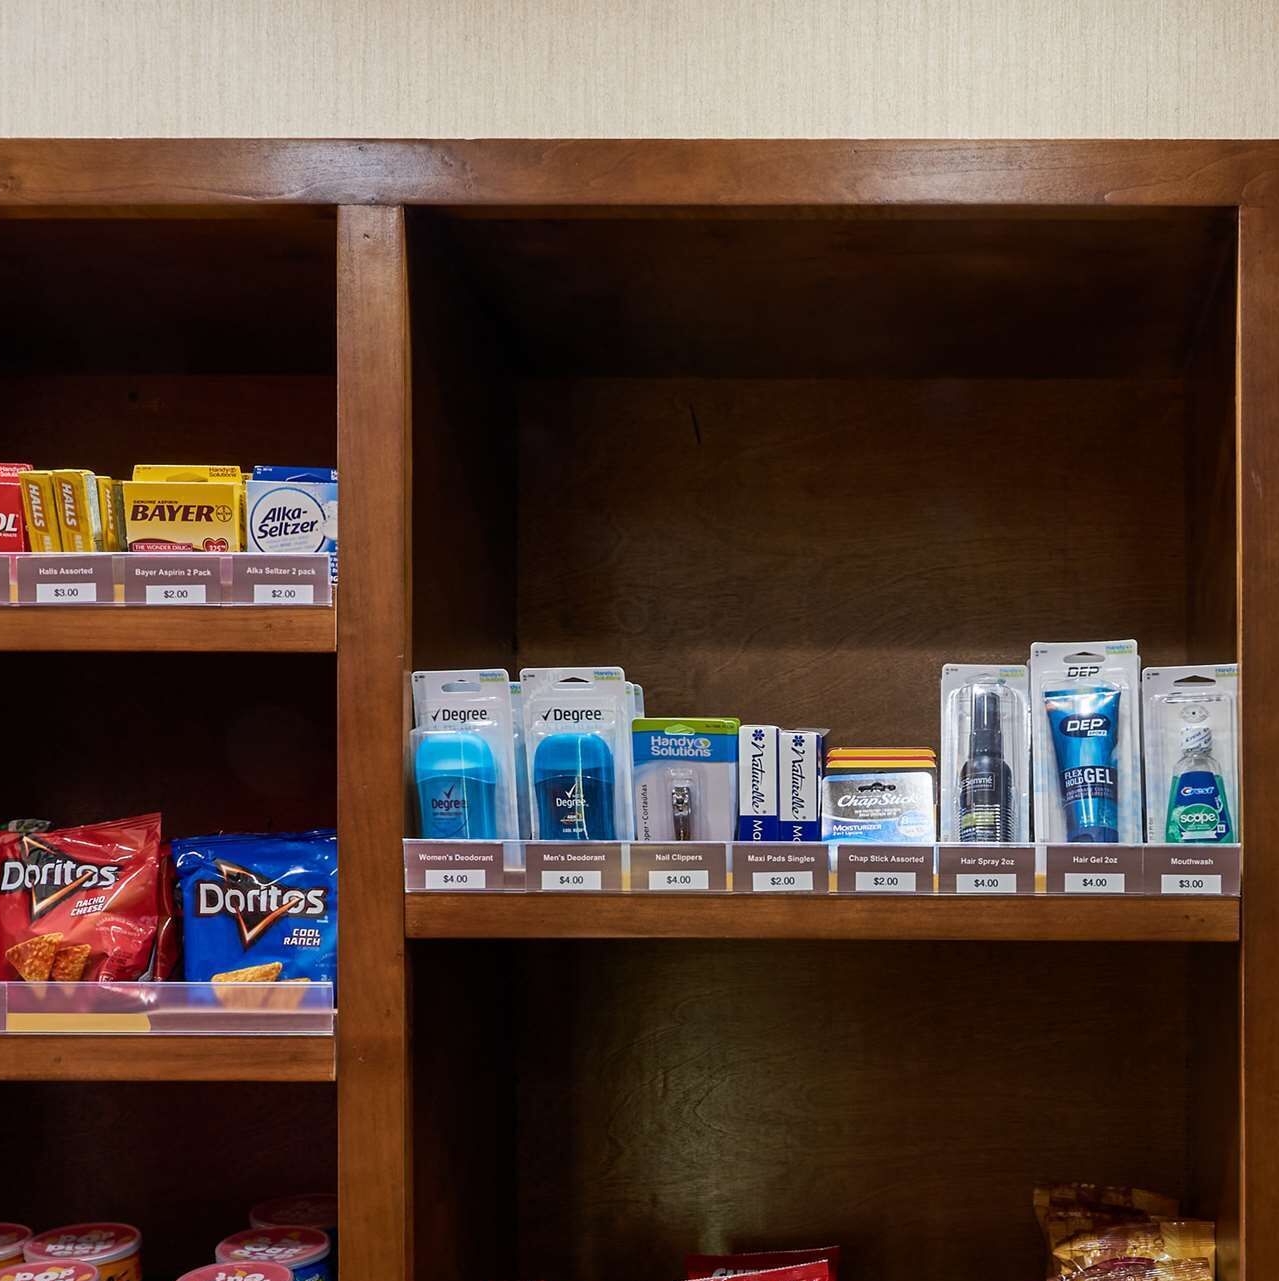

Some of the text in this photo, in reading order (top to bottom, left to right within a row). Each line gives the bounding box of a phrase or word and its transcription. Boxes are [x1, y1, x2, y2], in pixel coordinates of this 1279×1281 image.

[61, 483, 77, 527] HALLS
[130, 505, 215, 522] BAYER
[261, 507, 308, 524] Alka-
[257, 519, 319, 540] Seltzer
[441, 708, 488, 722] Degree
[553, 708, 603, 722] Degree
[1067, 720, 1105, 732] DEP
[651, 736, 694, 749] Handy
[651, 746, 711, 758] Solutions
[1064, 769, 1082, 780] FLEX
[1084, 768, 1113, 785] GEL
[1065, 777, 1084, 787] HOLD
[837, 795, 917, 808] ChapStick
[1179, 812, 1217, 826] scope
[419, 854, 494, 863] Women's Deodorant
[1170, 857, 1214, 866] Mouthwash
[1, 859, 119, 891] Doritos
[443, 874, 468, 885] $4.00
[1179, 879, 1204, 889] $3.00
[75, 896, 106, 906] NACHO
[199, 884, 326, 913] Doritos
[71, 904, 103, 916] CHEESE
[292, 928, 321, 937] COOL
[283, 938, 320, 946] RANCH
